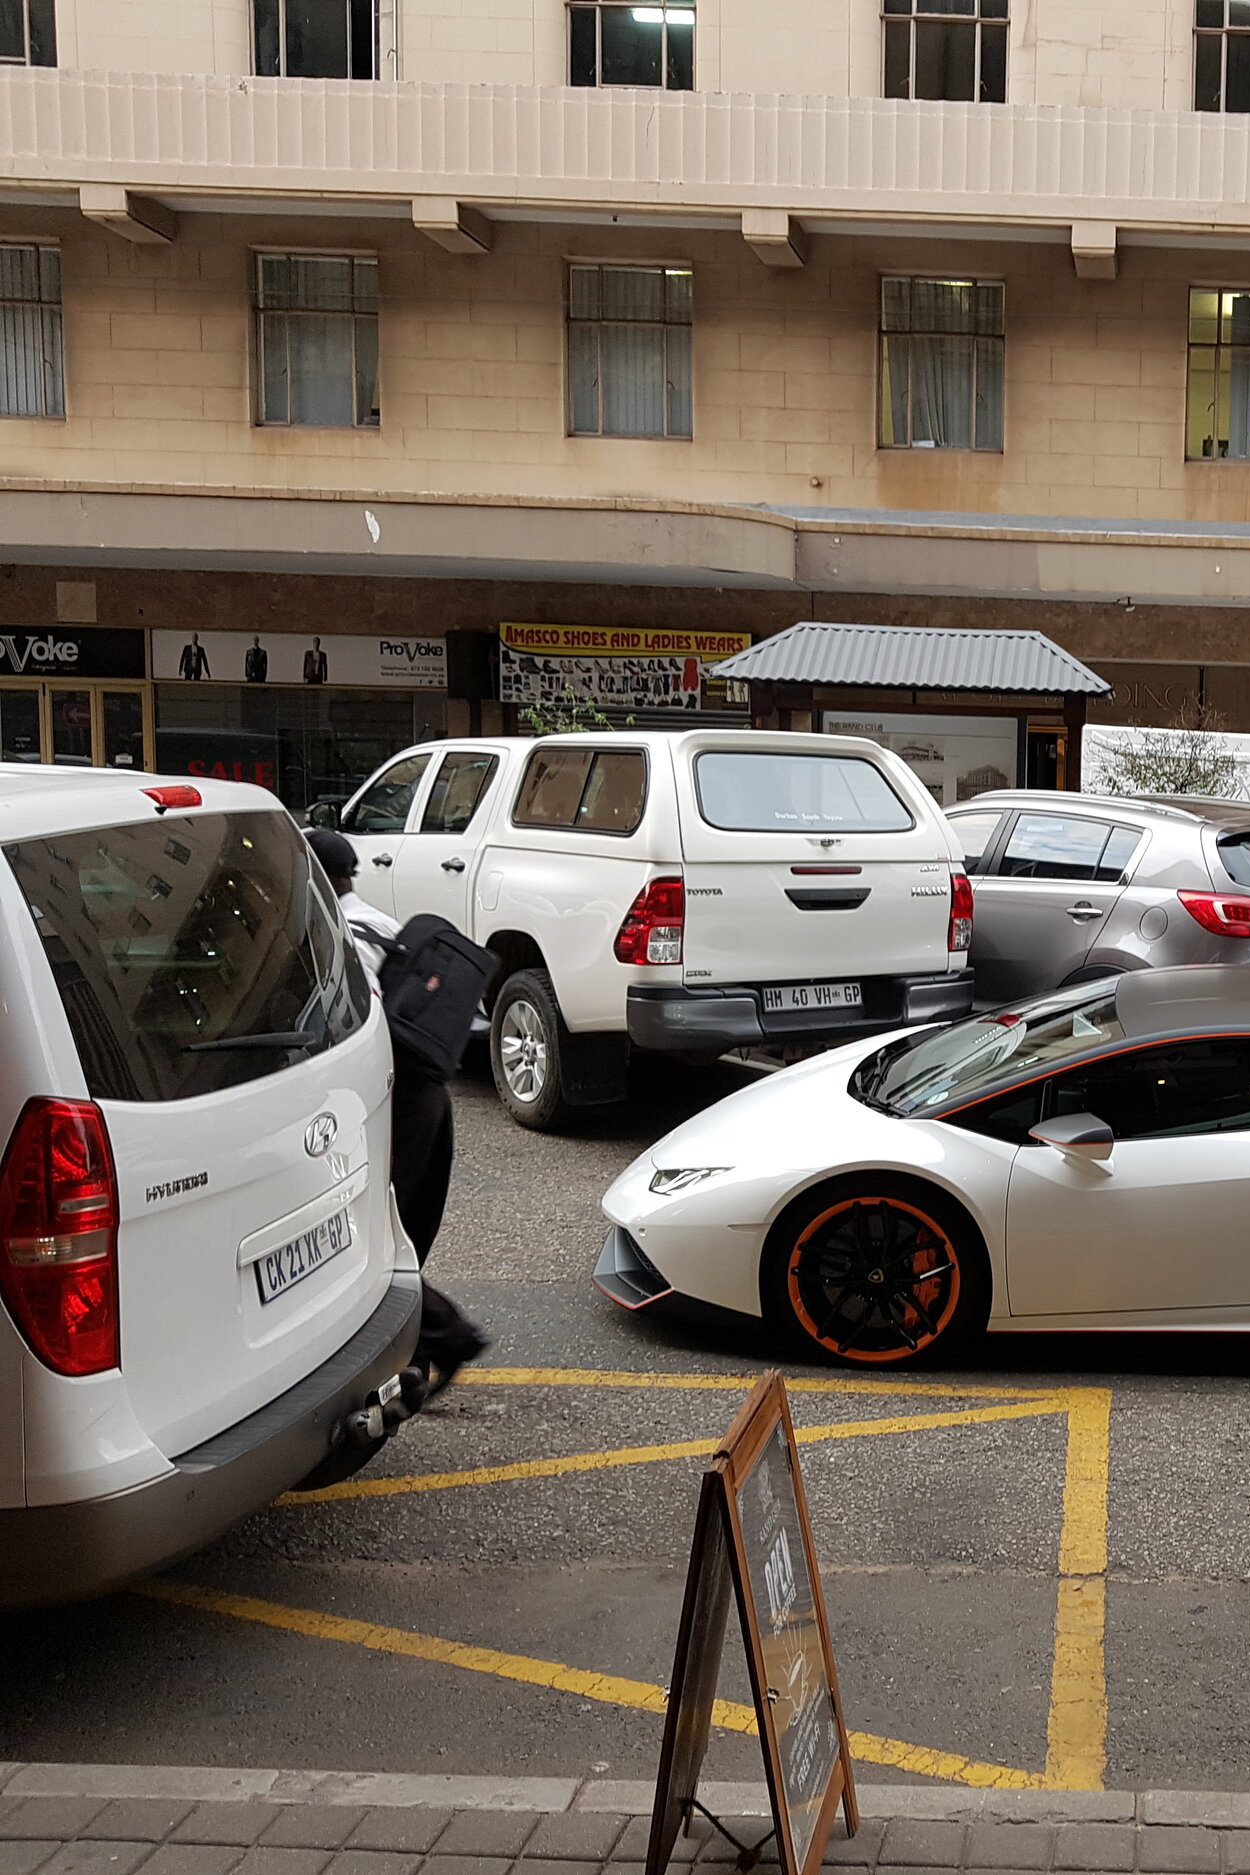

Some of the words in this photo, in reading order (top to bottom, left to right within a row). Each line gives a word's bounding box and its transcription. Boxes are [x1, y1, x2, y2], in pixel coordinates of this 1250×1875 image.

[380, 641, 443, 662] ProVoke
[505, 625, 560, 645] AMASCO
[564, 631, 607, 646] SHOES
[611, 633, 641, 648] AND
[645, 634, 691, 650] LADIES
[694, 636, 744, 653] WEARS
[187, 760, 274, 787] SALE
[687, 888, 724, 896] TOYOTA
[911, 885, 948, 897] HILUX
[765, 989, 783, 1008] HM
[792, 988, 808, 1006] 40
[814, 987, 832, 1004] VH
[843, 985, 860, 1003] GP
[266, 1249, 286, 1291] CK
[287, 1239, 305, 1280] 21
[304, 1227, 322, 1267] XK
[328, 1213, 342, 1250] GP
[762, 1522, 794, 1624] OPEN
